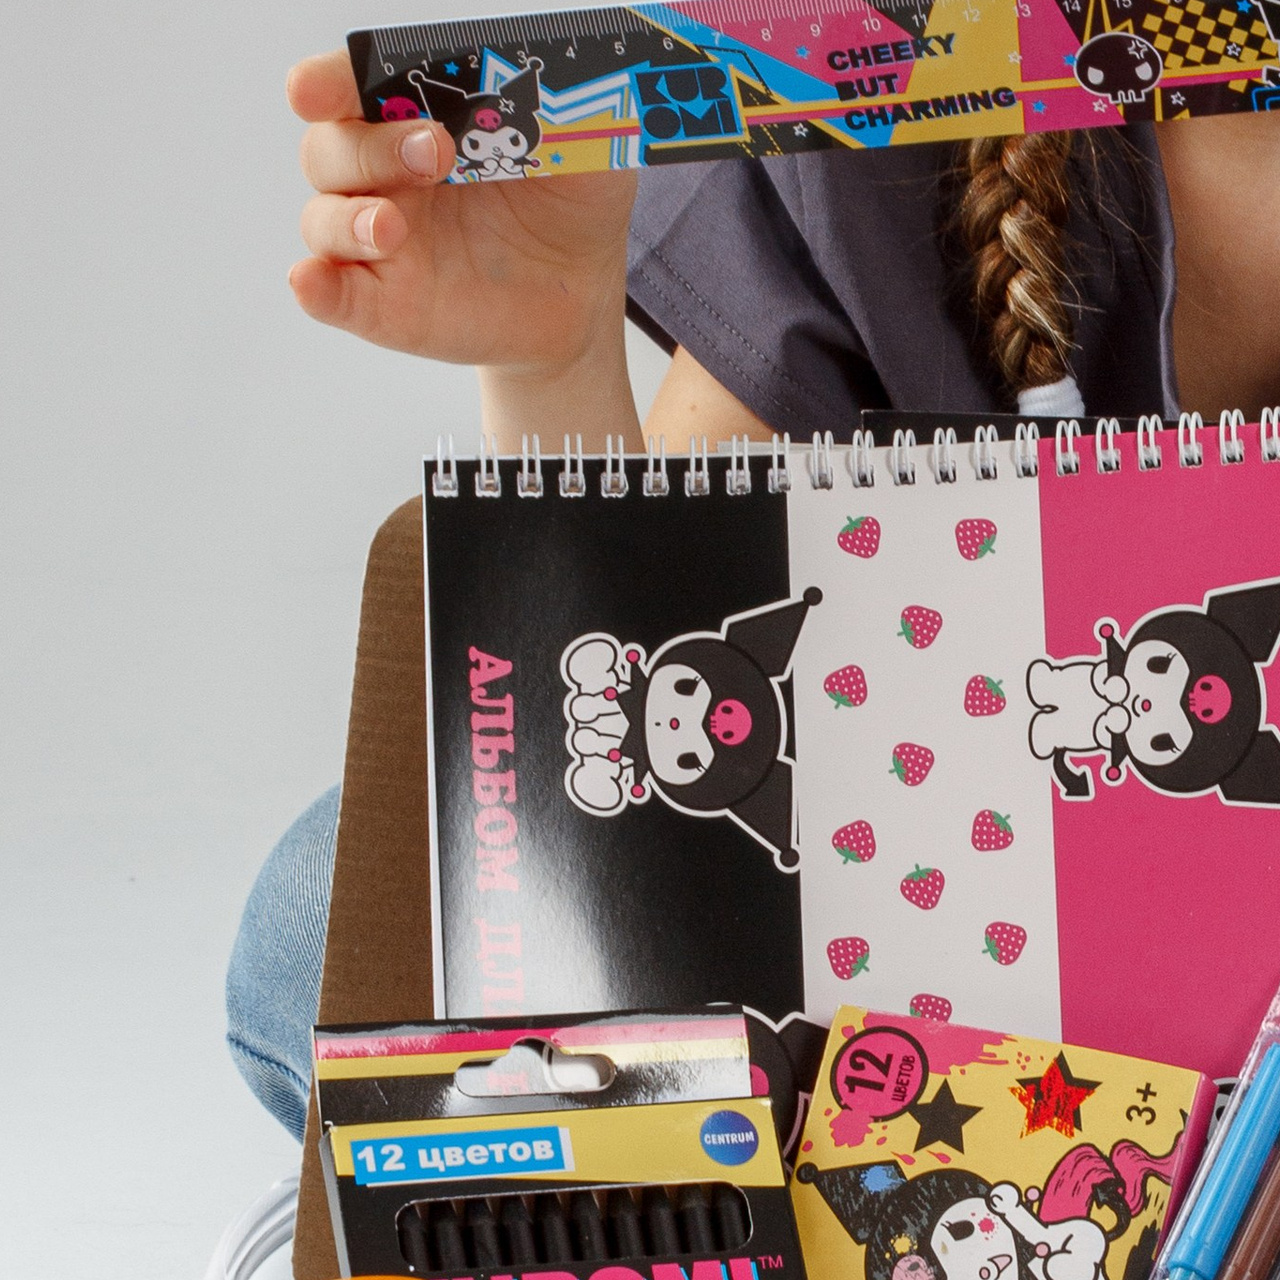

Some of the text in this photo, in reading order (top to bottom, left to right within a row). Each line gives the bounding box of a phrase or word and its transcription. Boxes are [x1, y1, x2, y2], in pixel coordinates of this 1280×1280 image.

[383, 62, 395, 76] 0
[421, 59, 429, 74] 1
[468, 55, 479, 70] 2
[517, 50, 527, 64] 3
[565, 46, 576, 60] 4
[615, 41, 625, 56] 5
[663, 37, 674, 51] 6
[713, 32, 723, 46] 7
[761, 28, 772, 42] 8
[810, 23, 822, 37] 9
[862, 18, 881, 34] 10
[911, 14, 928, 28] 11
[962, 9, 982, 23] 12
[1012, 3, 1032, 19] 13
[1062, 0, 1082, 14] 14
[827, 32, 955, 70] CHEEKY
[834, 74, 900, 102] BUT
[844, 88, 1016, 132] CHARMING
[466, 646, 520, 894] АЛЬБОМ
[474, 917, 525, 1018] ДЛ
[844, 1048, 893, 1093] 12
[892, 1054, 915, 1103] ЦВЕТОВ
[1125, 1082, 1157, 1125] 3+
[357, 1139, 556, 1173] 12 цветов
[703, 1130, 755, 1146] CENTRUM
